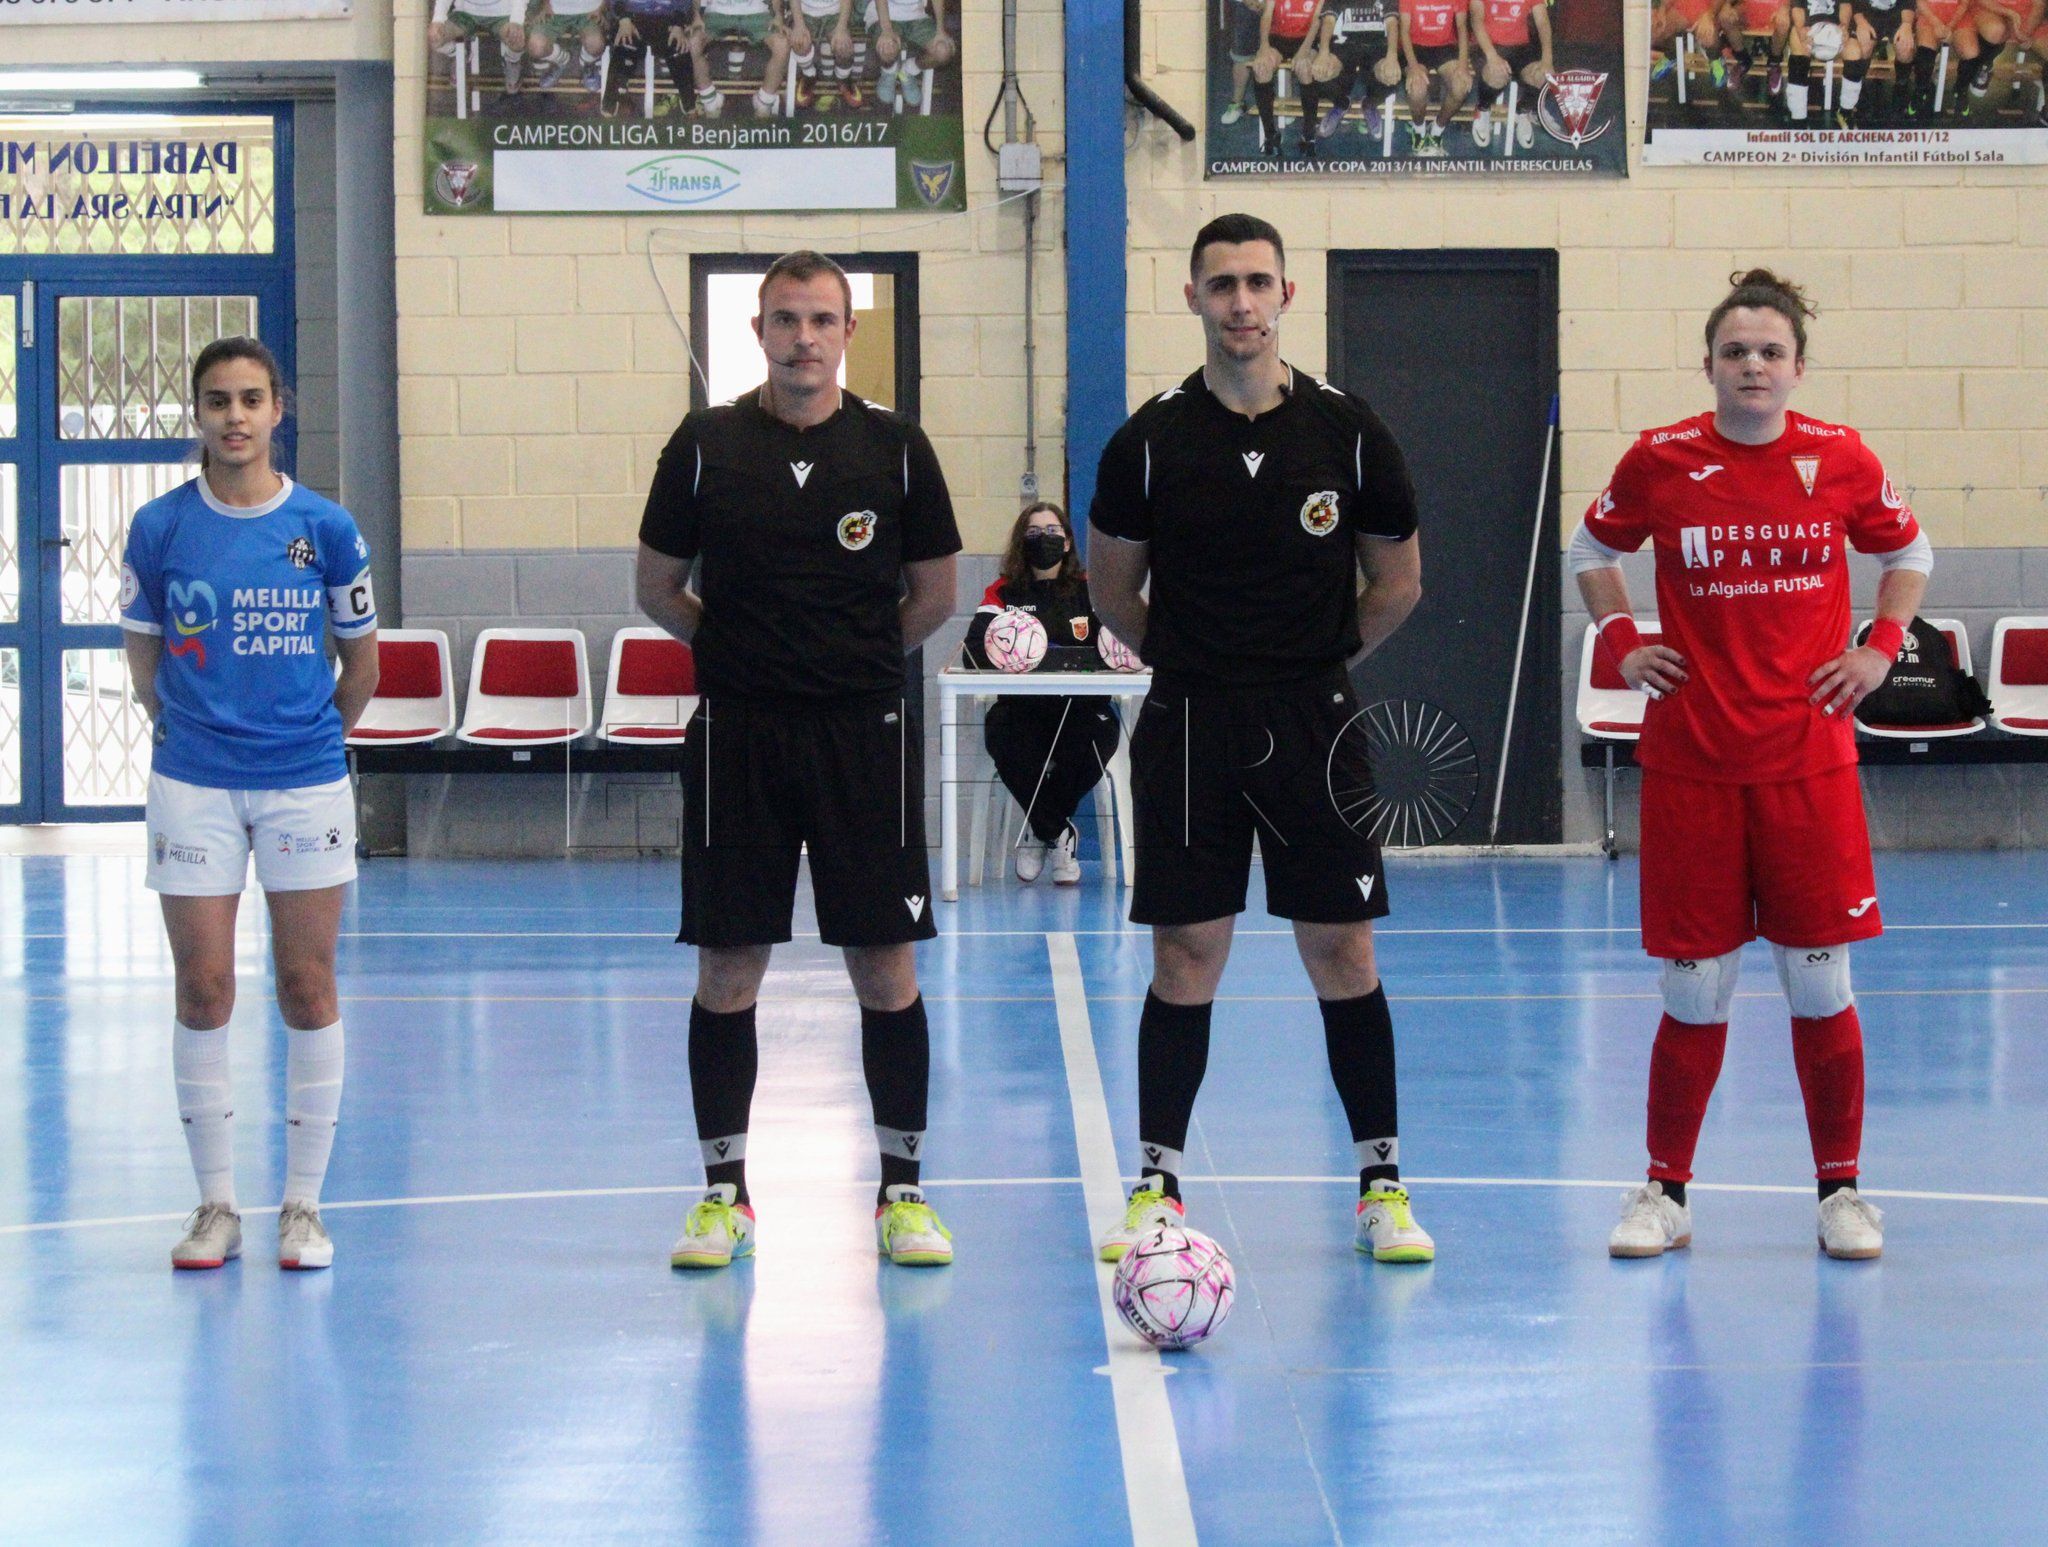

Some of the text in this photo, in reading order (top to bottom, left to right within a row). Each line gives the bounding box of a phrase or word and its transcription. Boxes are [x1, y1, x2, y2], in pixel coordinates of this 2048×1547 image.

[493, 124, 602, 145] CAMPEON
[609, 124, 658, 145] LIGA
[691, 124, 790, 149] Benjamin
[802, 122, 888, 144] 2016/17
[1746, 131, 1950, 143] Infantil SOL DE ARCHENA 2011/12
[1211, 159, 1593, 174] CAMPEON LIGA Y COPA 2013/14 INFANTIL INTERESCUELAS
[1703, 151, 1777, 163] CAMPEON
[1801, 150, 1860, 163] División
[1864, 150, 1919, 162] Infantil
[1923, 149, 1970, 162] Fútbol
[1974, 149, 2004, 162] Sala
[647, 166, 723, 192] FRANSA
[1711, 521, 1832, 541] DESGUACE
[1713, 545, 1831, 568] PARIS
[1689, 574, 1825, 599] La Algaida FUTSAL
[232, 588, 321, 609] MELILLA
[350, 585, 369, 616] C
[232, 611, 309, 632] SPORT
[232, 635, 316, 656] CAPITAL
[168, 848, 207, 865] MELILLA
